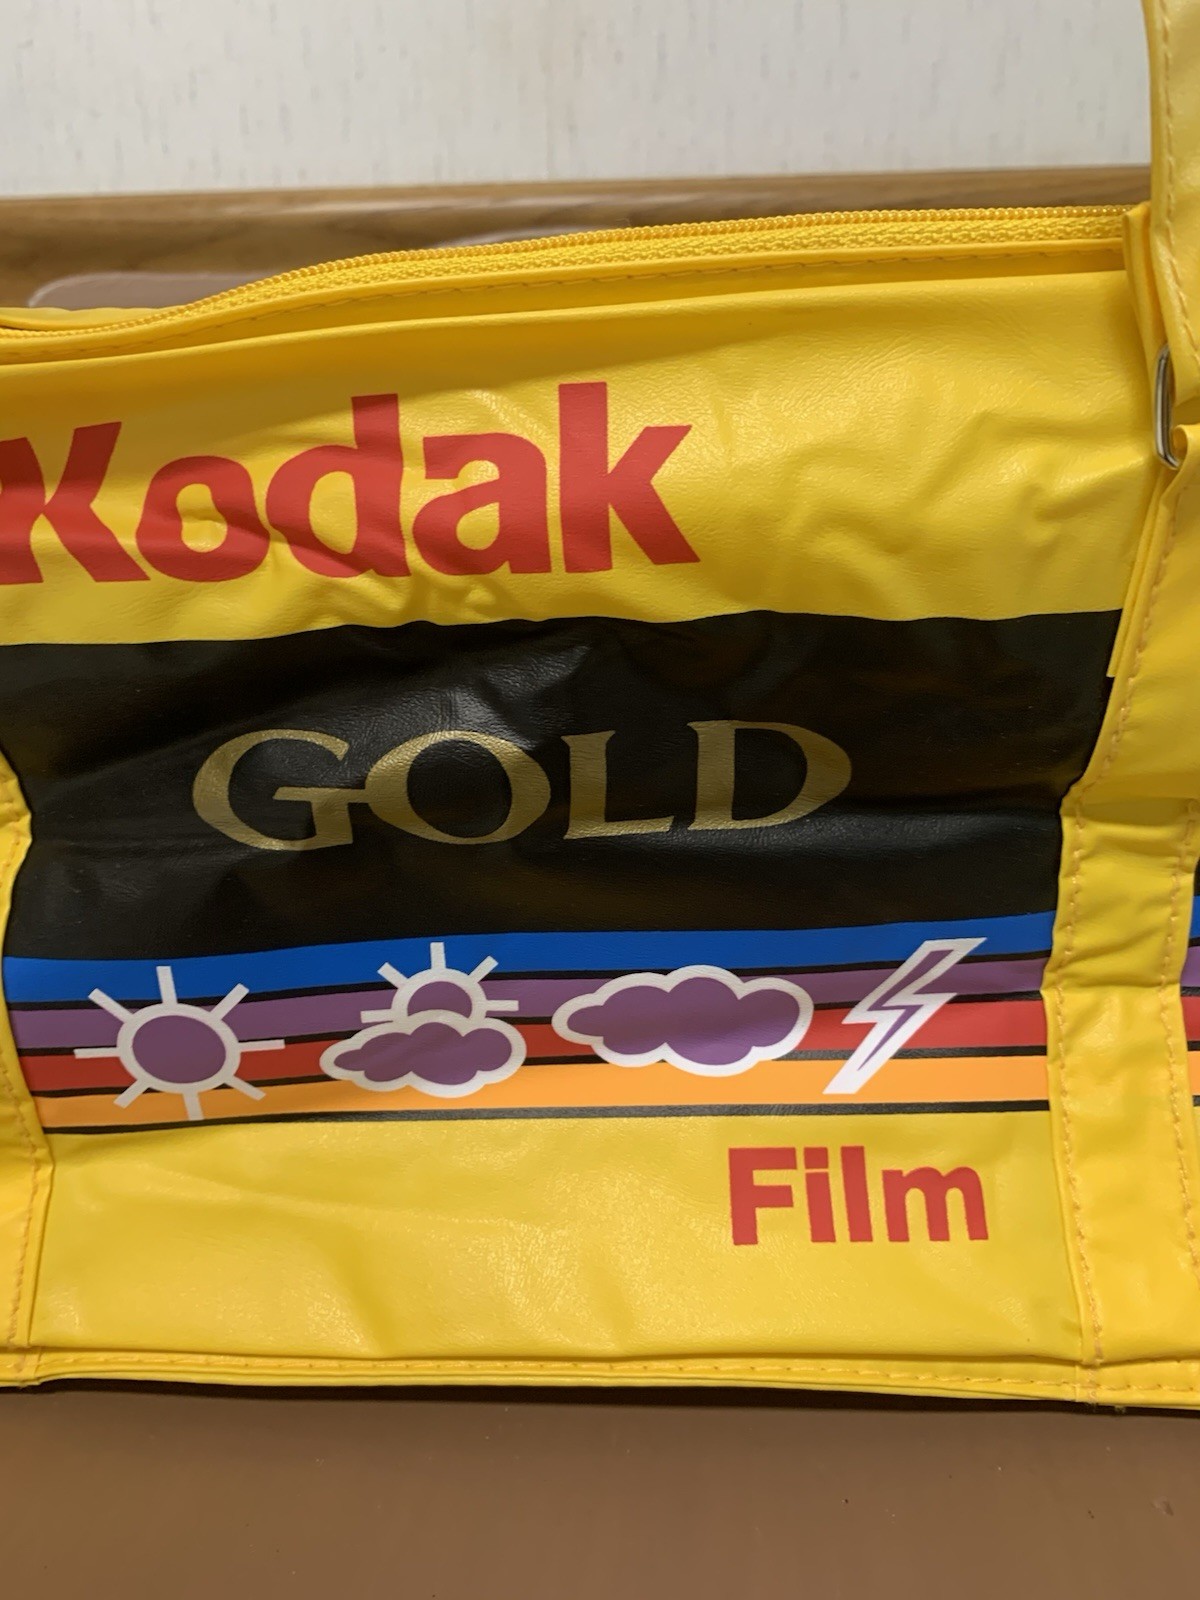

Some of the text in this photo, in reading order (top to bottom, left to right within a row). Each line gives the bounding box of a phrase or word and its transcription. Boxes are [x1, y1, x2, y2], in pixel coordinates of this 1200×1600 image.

[0, 382, 700, 584] Kodak
[192, 720, 852, 851] GOLD
[729, 1146, 989, 1245] Film
